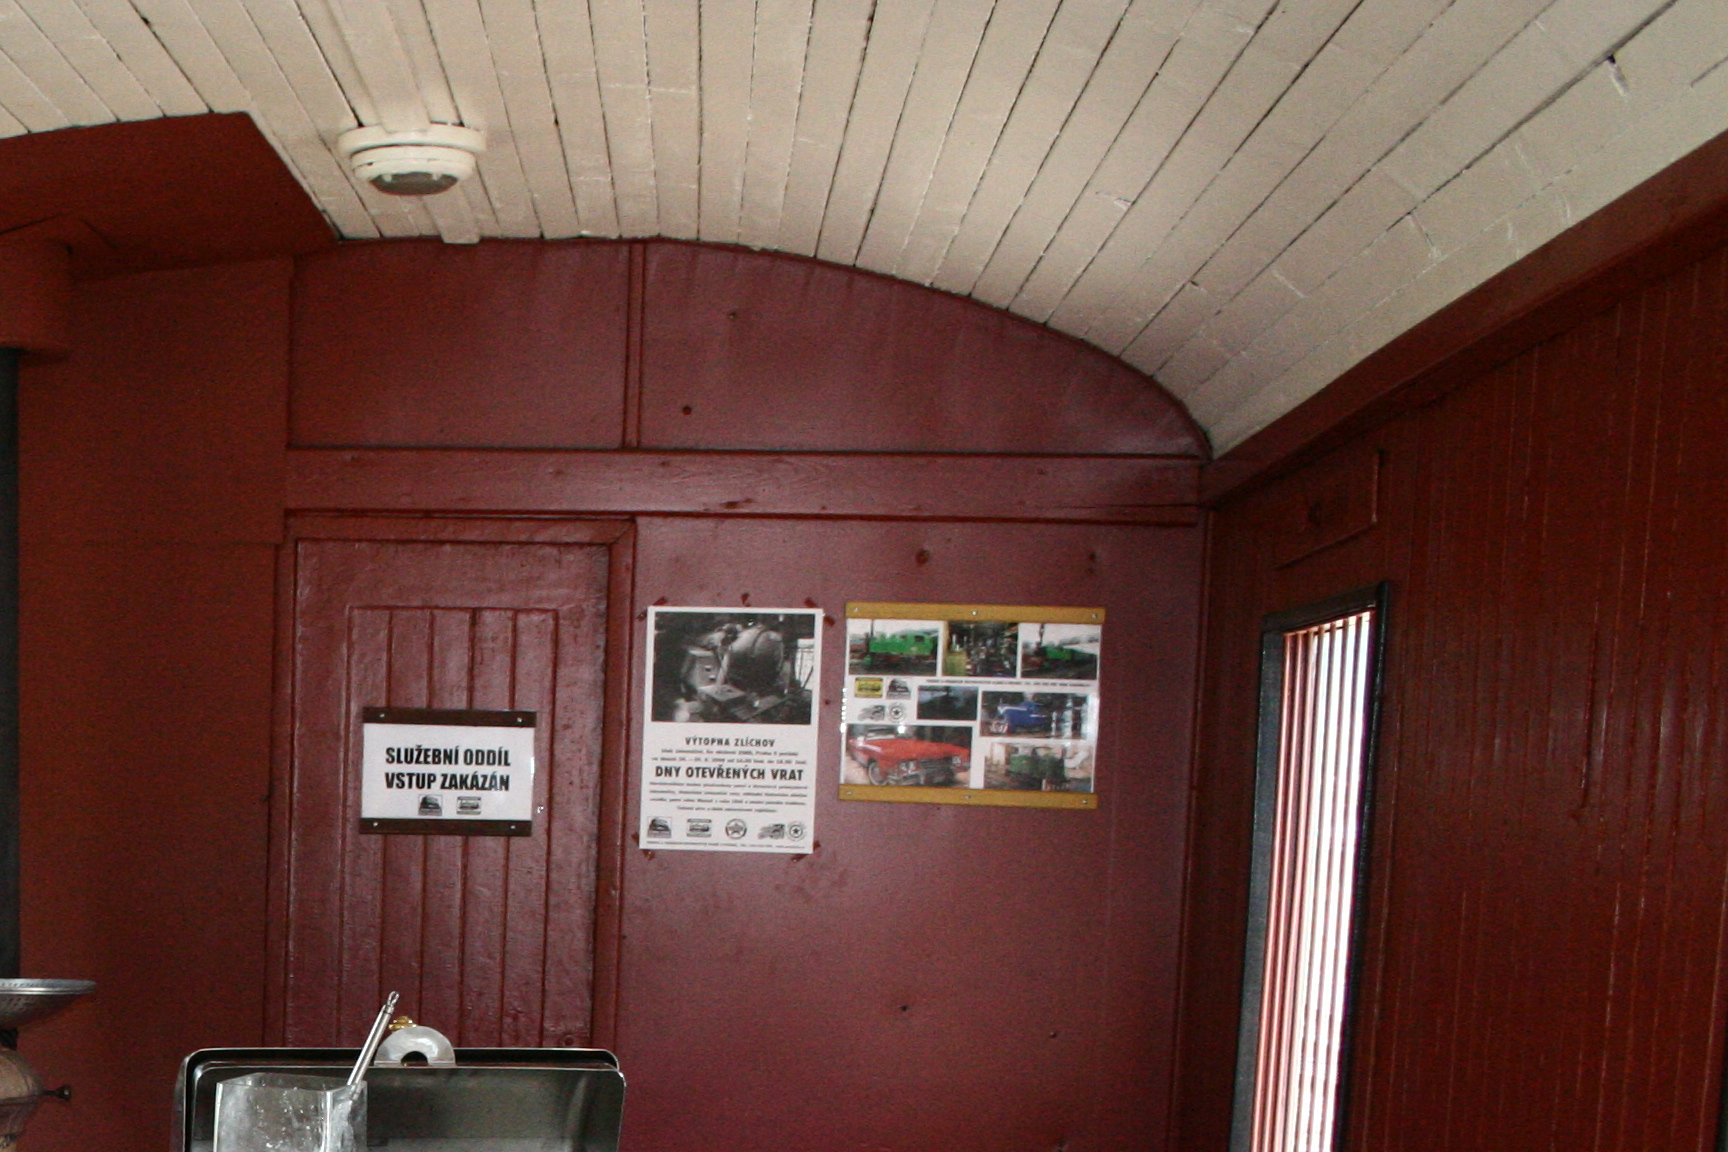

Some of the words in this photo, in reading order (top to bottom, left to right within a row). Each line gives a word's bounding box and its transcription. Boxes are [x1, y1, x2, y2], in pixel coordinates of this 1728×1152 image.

[684, 735, 730, 746] VÝTOPNA
[385, 745, 459, 765] SLUŽEBNÍ
[463, 746, 511, 766] ODDÍL
[385, 772, 437, 789] VSTUP
[440, 771, 510, 791] ZAKÁZÁN
[655, 766, 681, 777] DNY
[685, 764, 766, 779] OTEVŘENÝCH
[771, 768, 804, 781] VRAT
